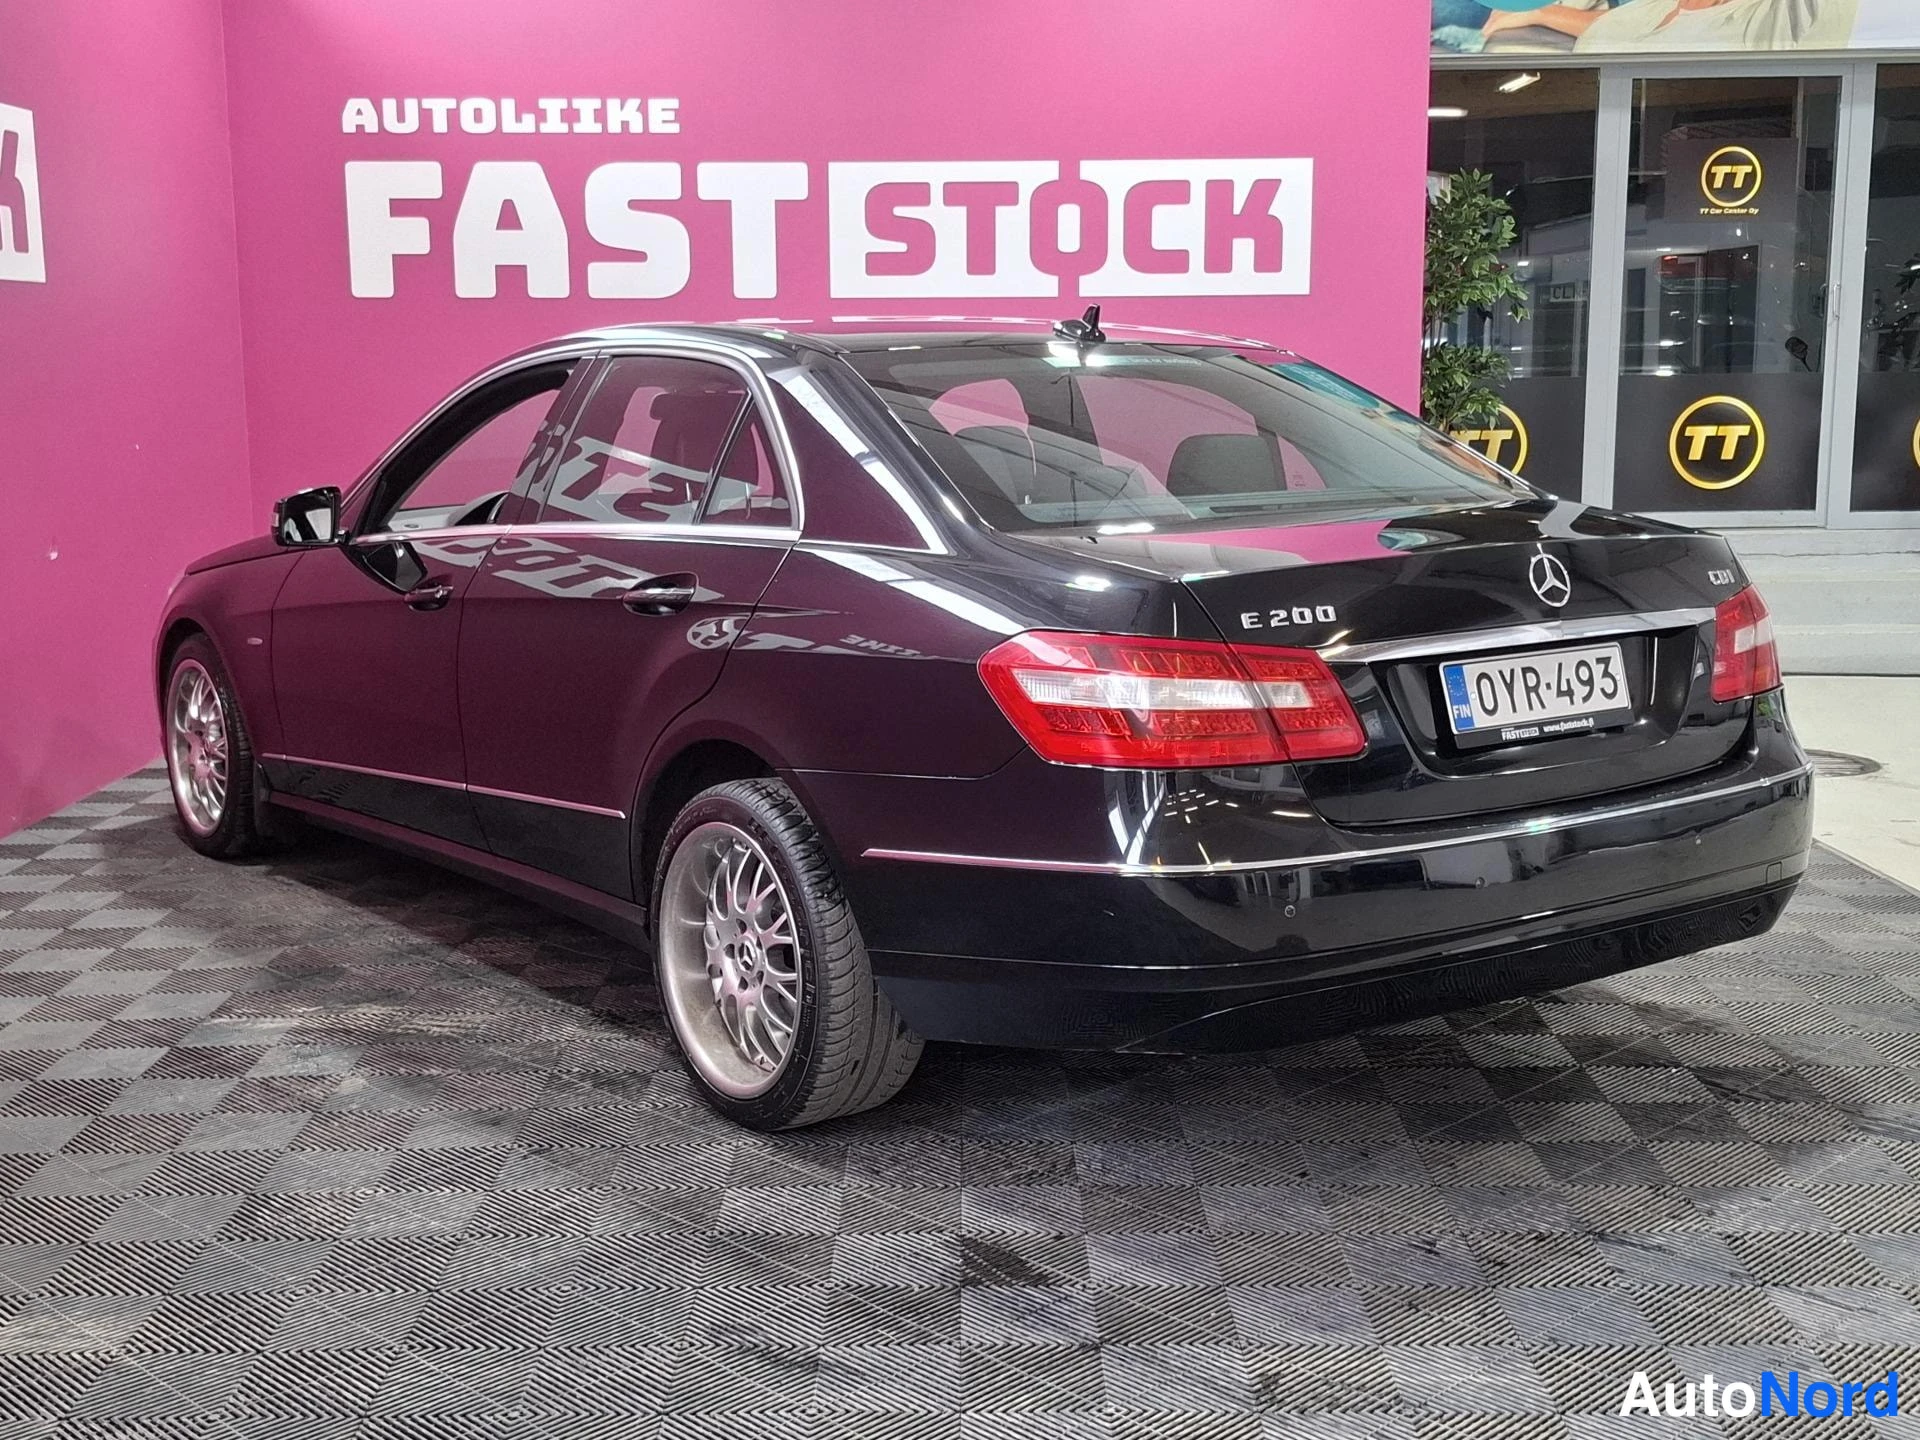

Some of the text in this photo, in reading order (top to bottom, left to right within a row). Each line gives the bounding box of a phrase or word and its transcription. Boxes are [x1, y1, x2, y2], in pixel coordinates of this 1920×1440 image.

[342, 98, 680, 134] AUTOLIIKE
[1710, 165, 1753, 189] TT
[1684, 425, 1750, 461] TT
[1708, 569, 1735, 585] CDI
[1241, 605, 1337, 630] E 200
[1475, 656, 1619, 717] OYR-493
[1453, 704, 1471, 719] FIN
